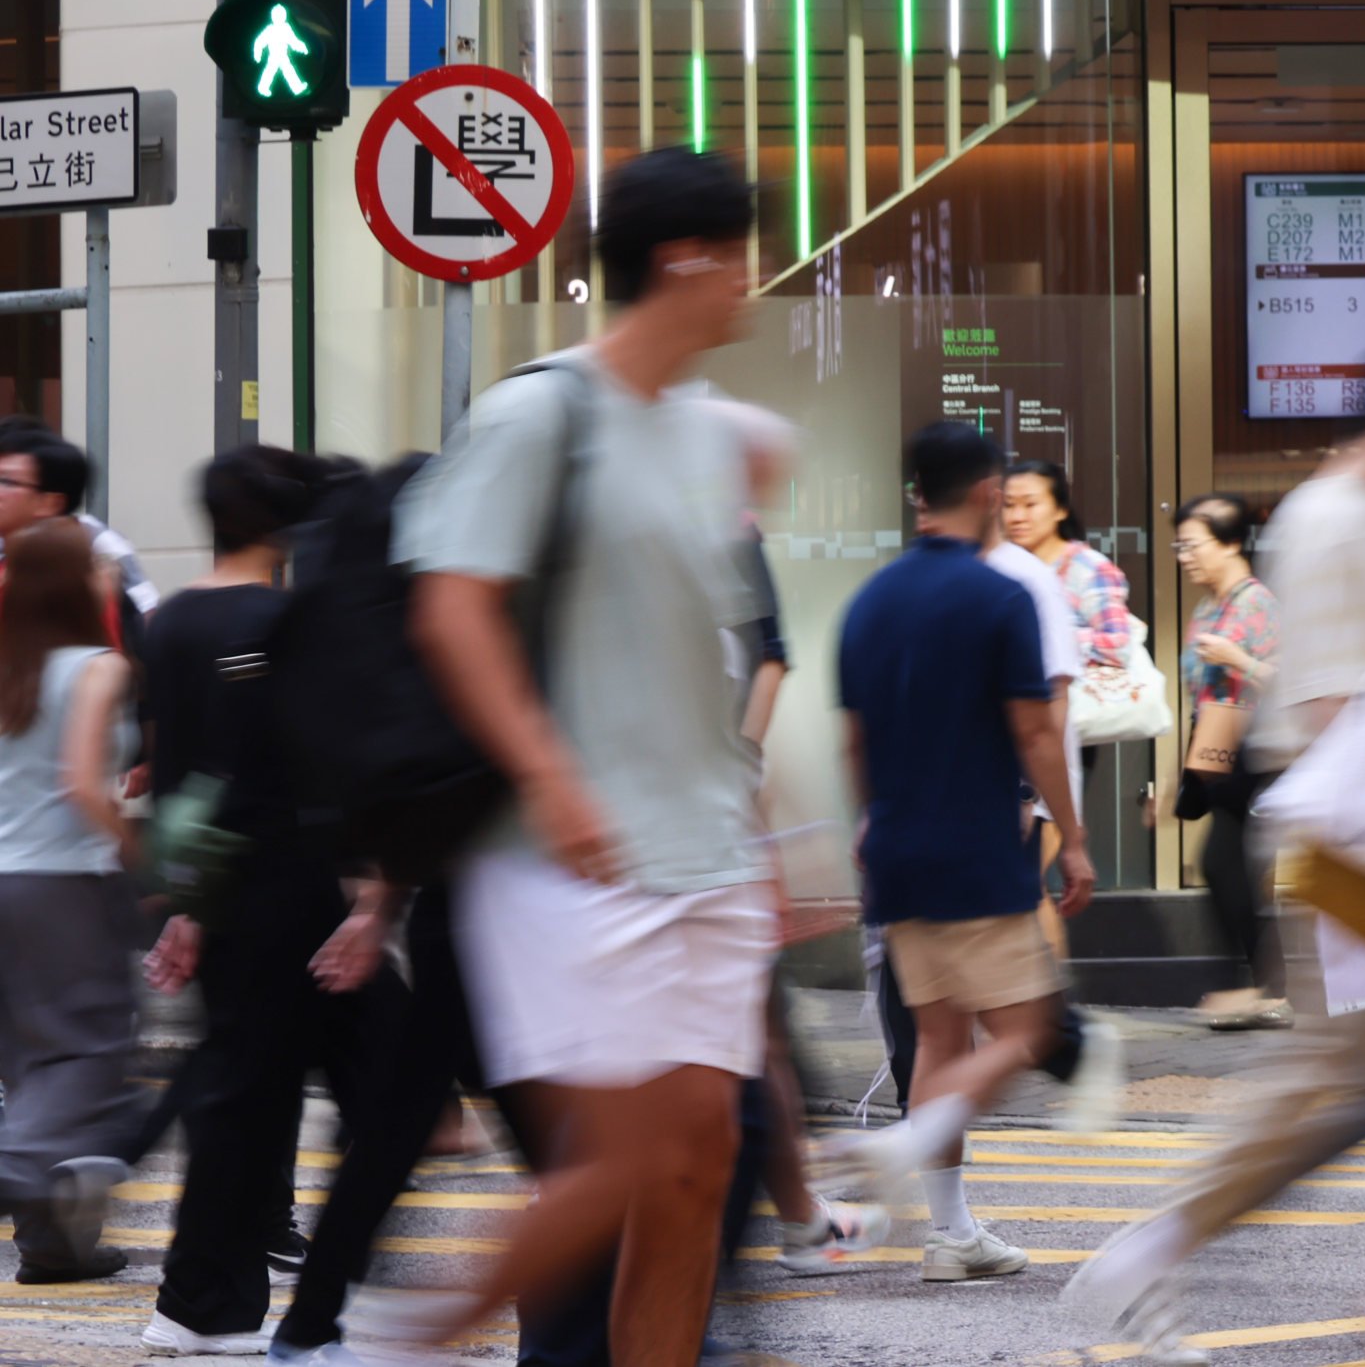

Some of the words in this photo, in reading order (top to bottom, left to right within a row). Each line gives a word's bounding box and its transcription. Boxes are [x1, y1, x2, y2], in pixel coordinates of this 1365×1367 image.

[48, 107, 129, 138] Street
[1267, 213, 1313, 229] C239
[1338, 213, 1363, 229] M1
[1267, 230, 1313, 246] D207
[1338, 230, 1365, 245] M2
[1338, 246, 1363, 262] M1
[1269, 297, 1315, 314] B515
[1347, 296, 1358, 313] 3
[943, 344, 999, 356] Welcome
[942, 384, 972, 393] Central
[972, 384, 1000, 394] Branch
